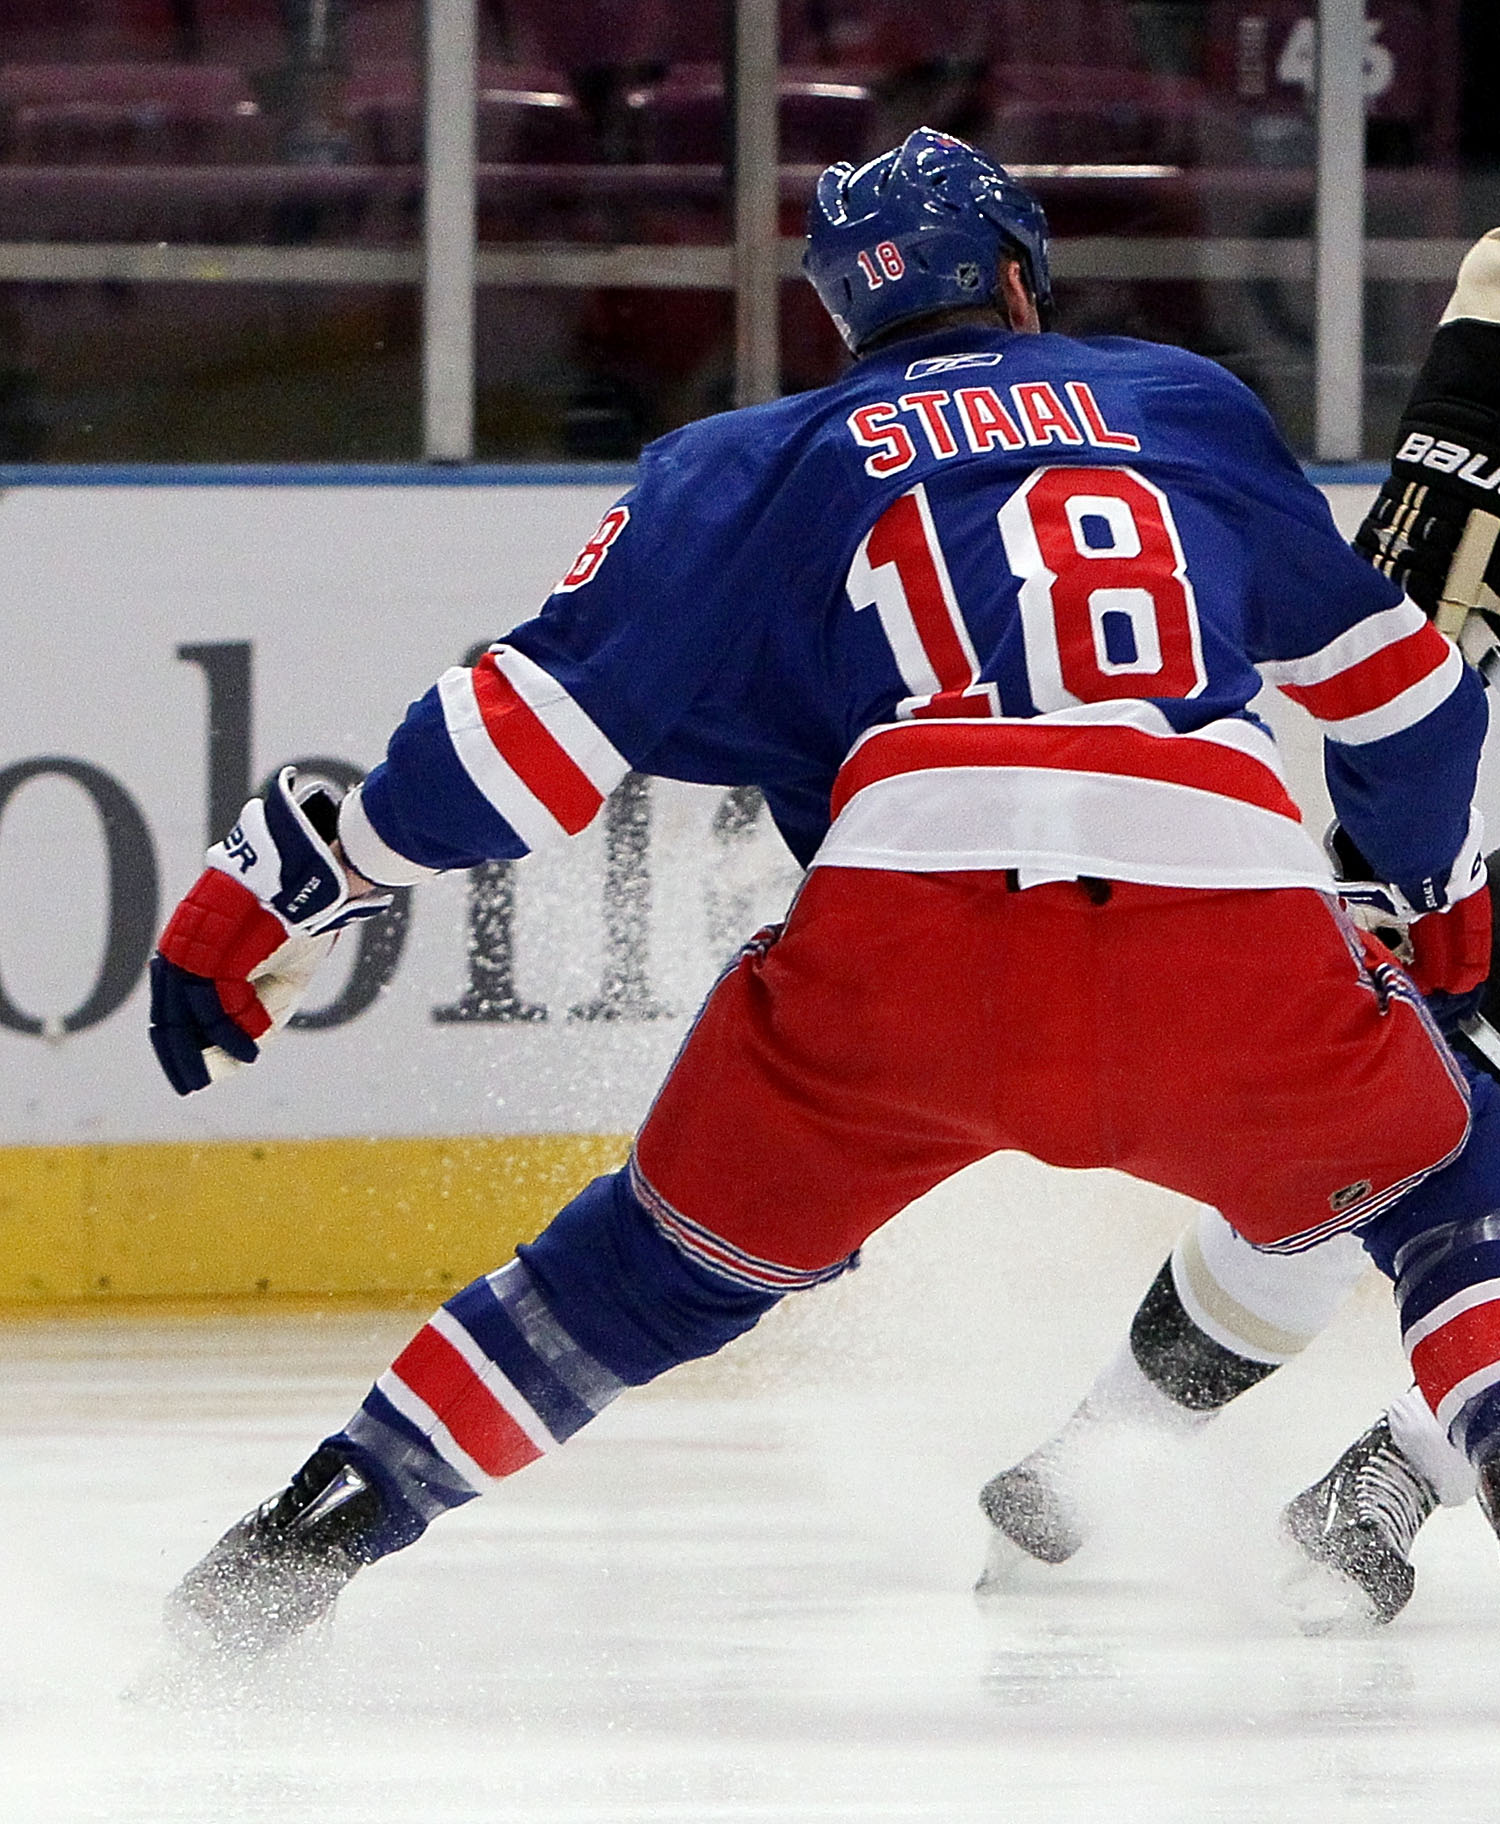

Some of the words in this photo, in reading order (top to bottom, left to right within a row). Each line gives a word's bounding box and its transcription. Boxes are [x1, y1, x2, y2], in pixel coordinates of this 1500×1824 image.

[857, 241, 906, 290] 18
[847, 380, 1142, 480] STAAL
[845, 463, 1209, 719] 18
